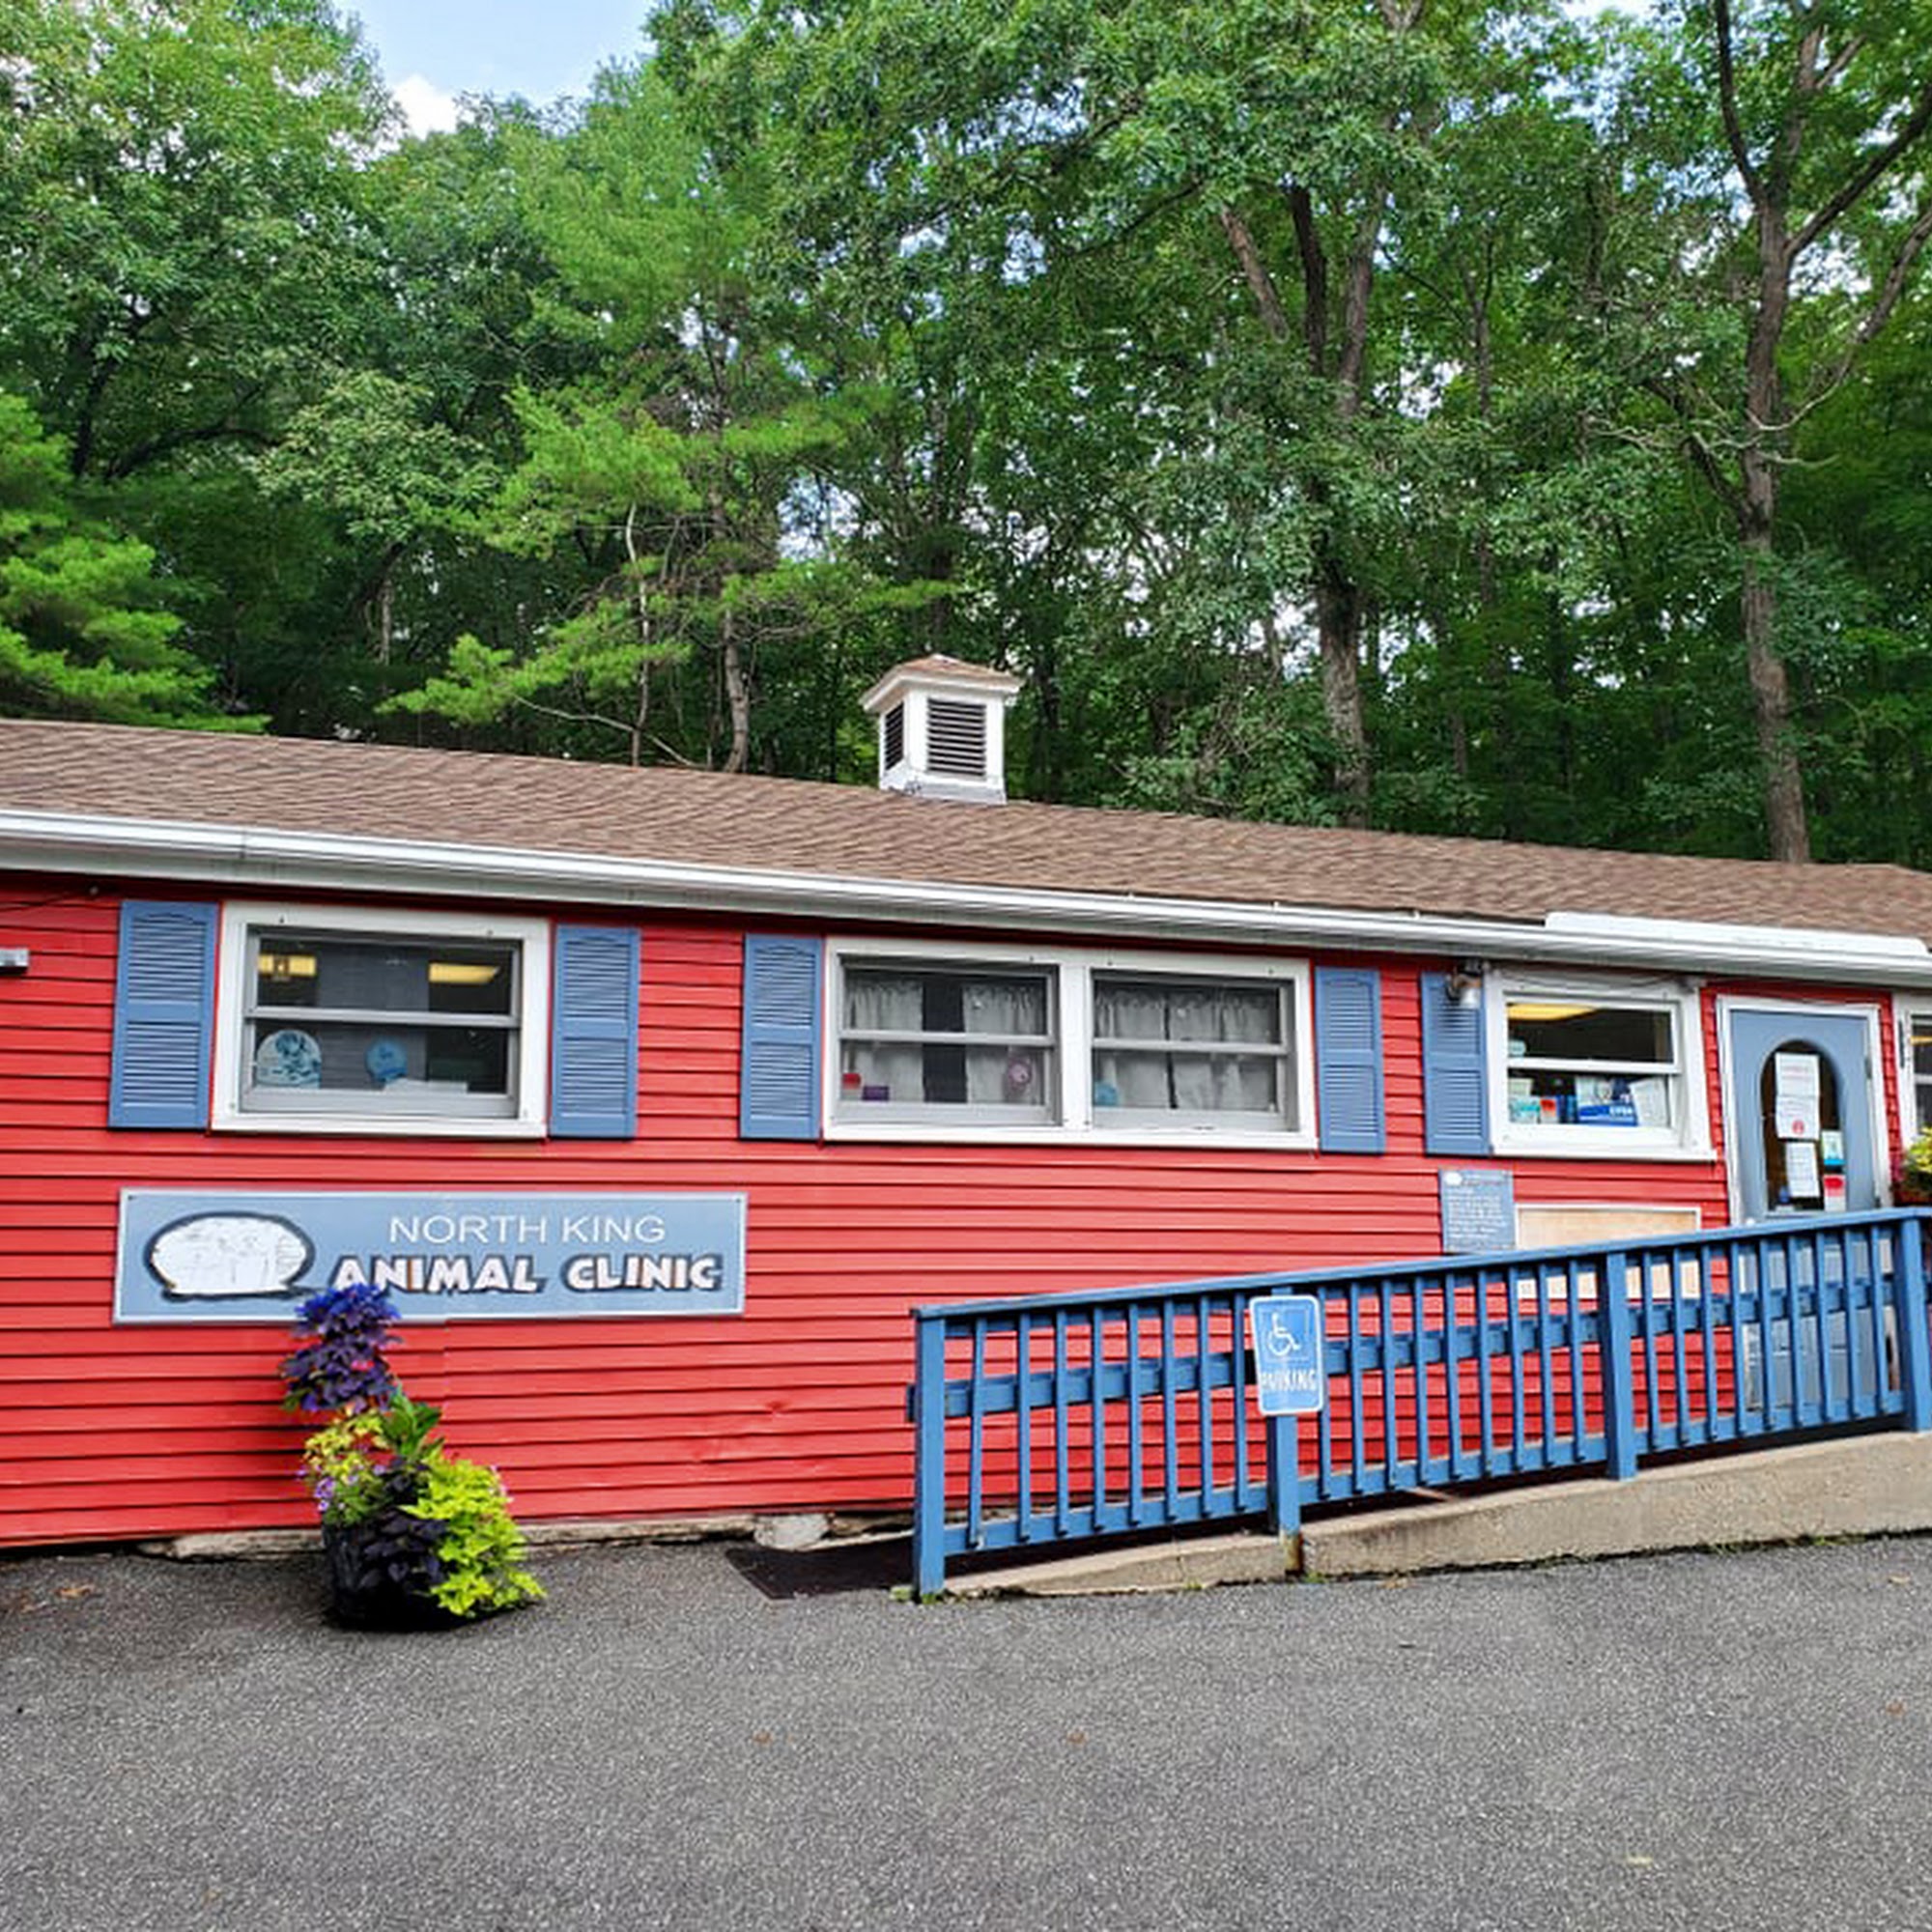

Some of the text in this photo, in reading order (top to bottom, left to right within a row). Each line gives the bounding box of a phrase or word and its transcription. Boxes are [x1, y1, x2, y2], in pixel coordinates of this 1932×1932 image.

[389, 1214, 666, 1244] NORTH KING
[331, 1255, 723, 1294] ANIMAL CLINIC
